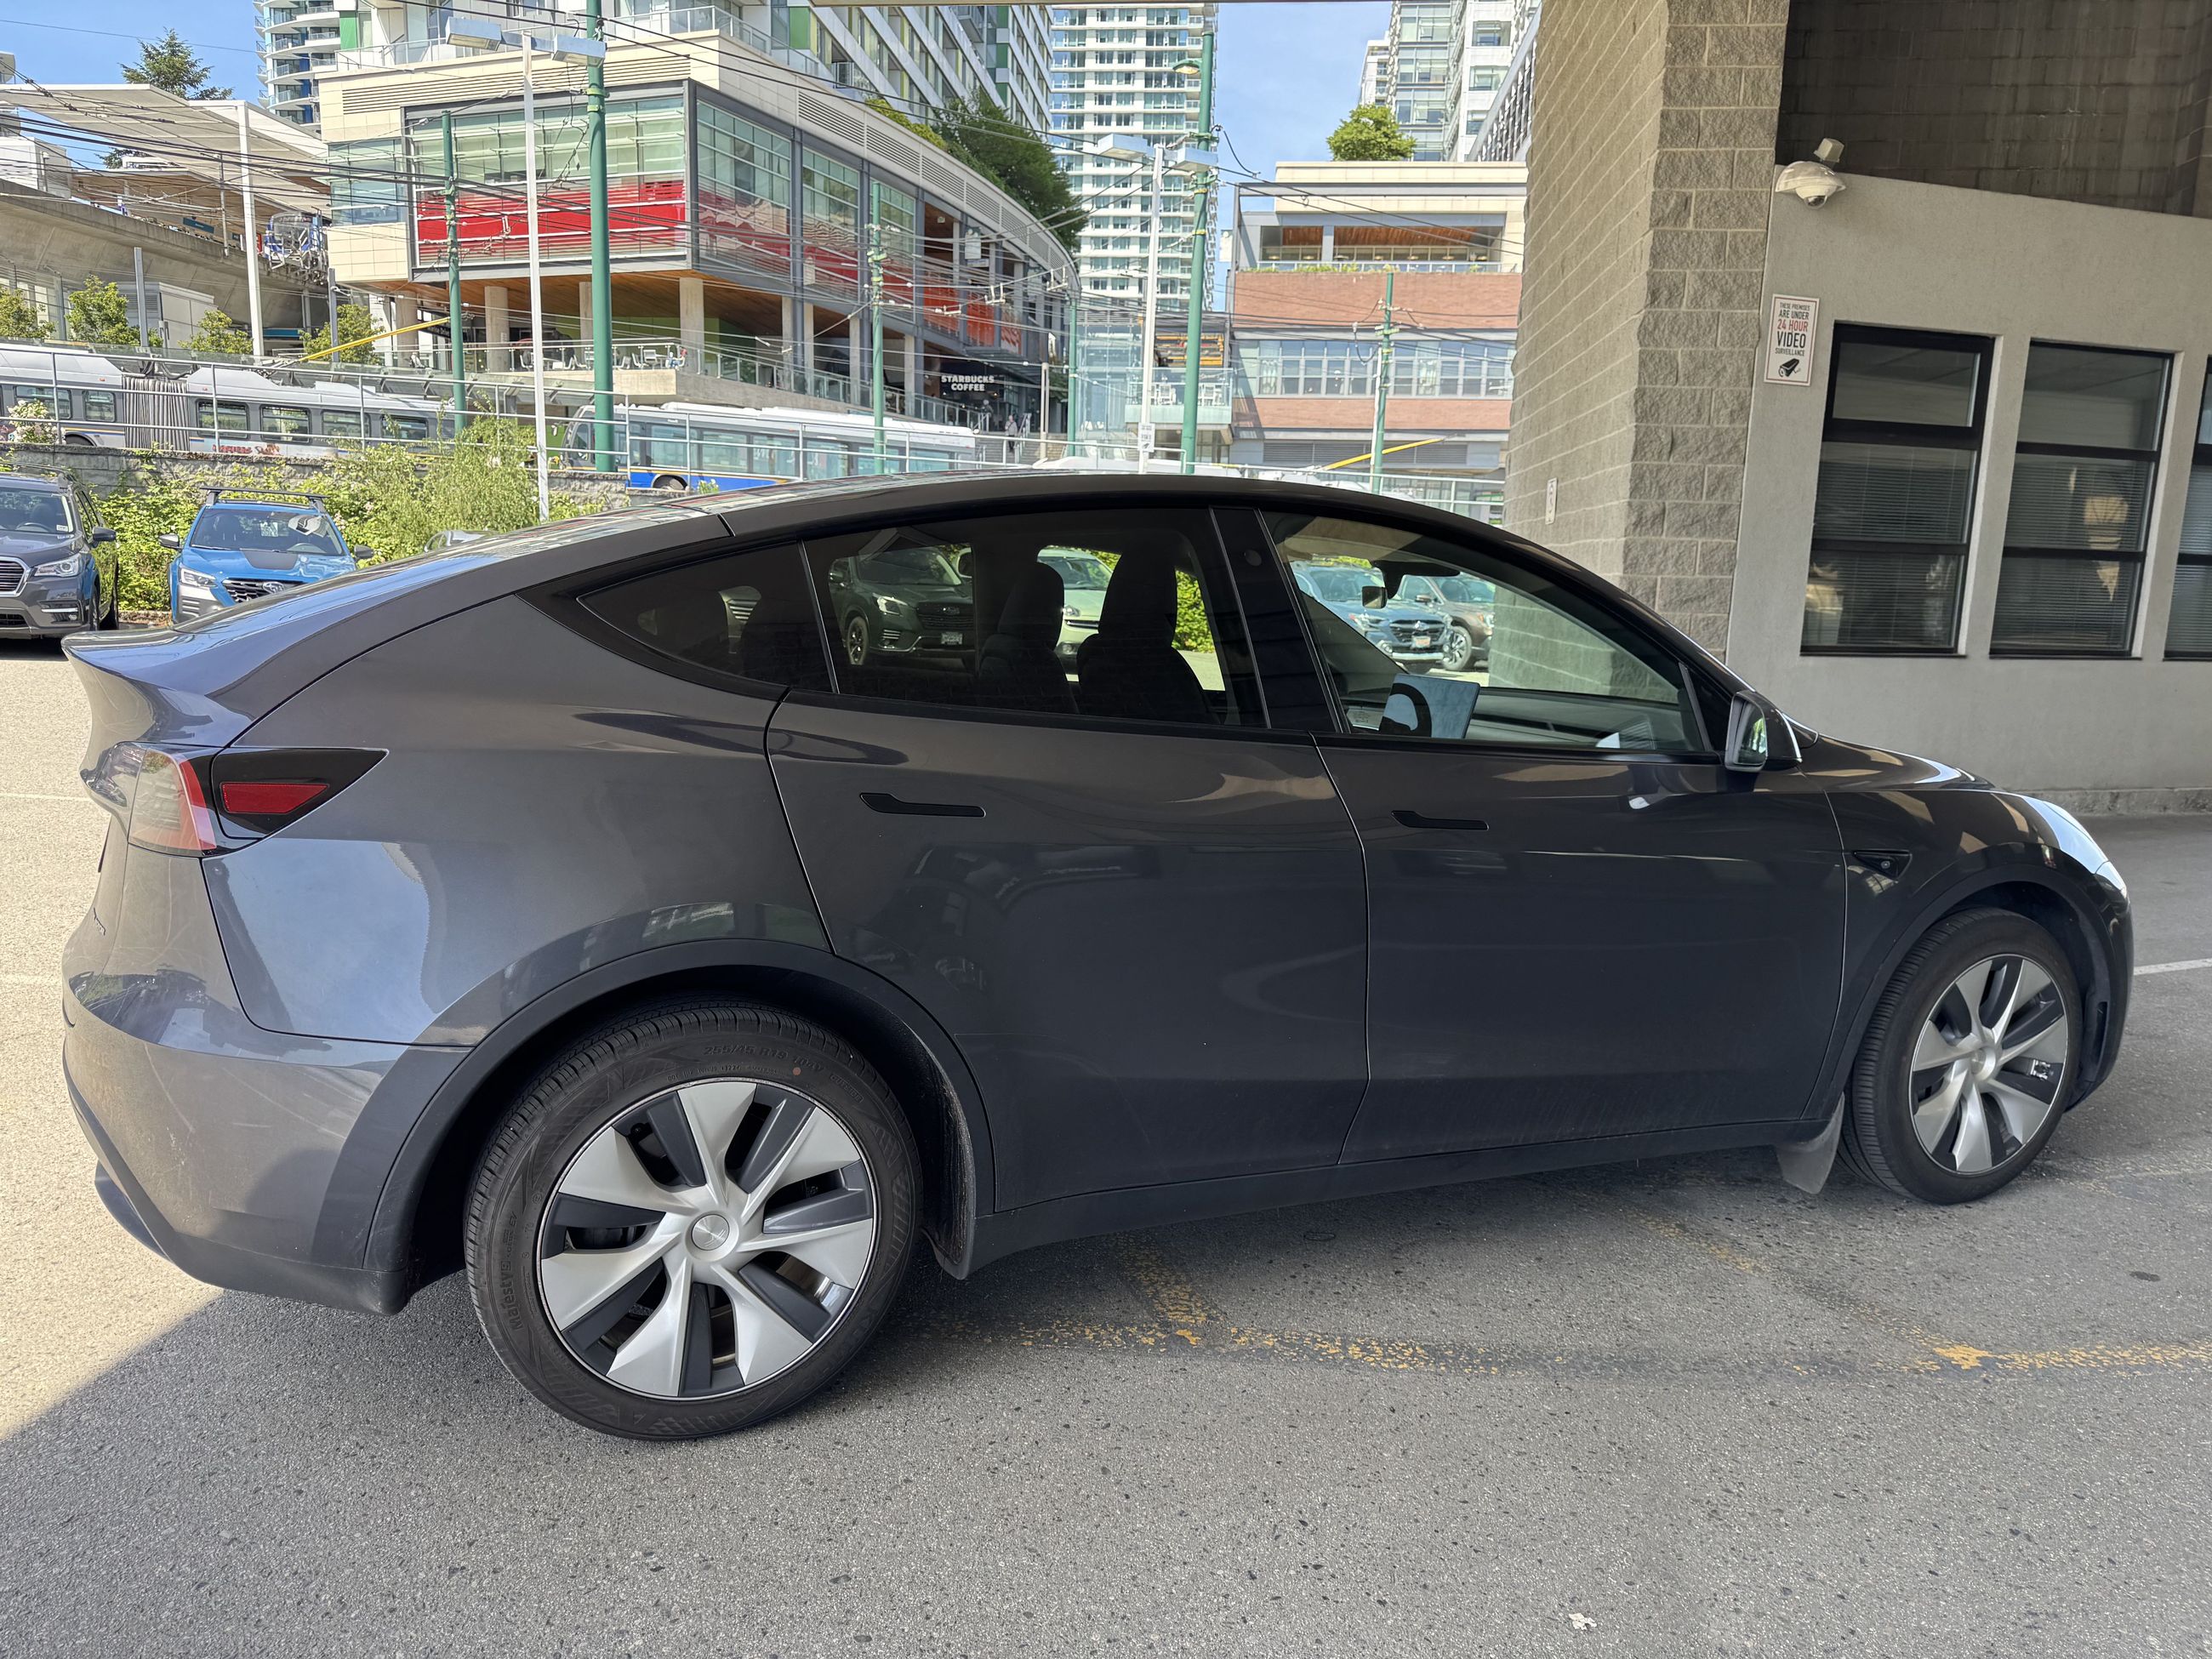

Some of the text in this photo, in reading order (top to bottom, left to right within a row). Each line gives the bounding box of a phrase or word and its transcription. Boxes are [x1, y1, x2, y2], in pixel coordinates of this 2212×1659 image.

[1778, 310, 1810, 320] ARE UNDER
[1777, 319, 1809, 332] 24 HOUR
[1777, 331, 1806, 348] VIDEO
[1775, 348, 1805, 356] SURVEILLANCE
[951, 383, 985, 391] COFFEE
